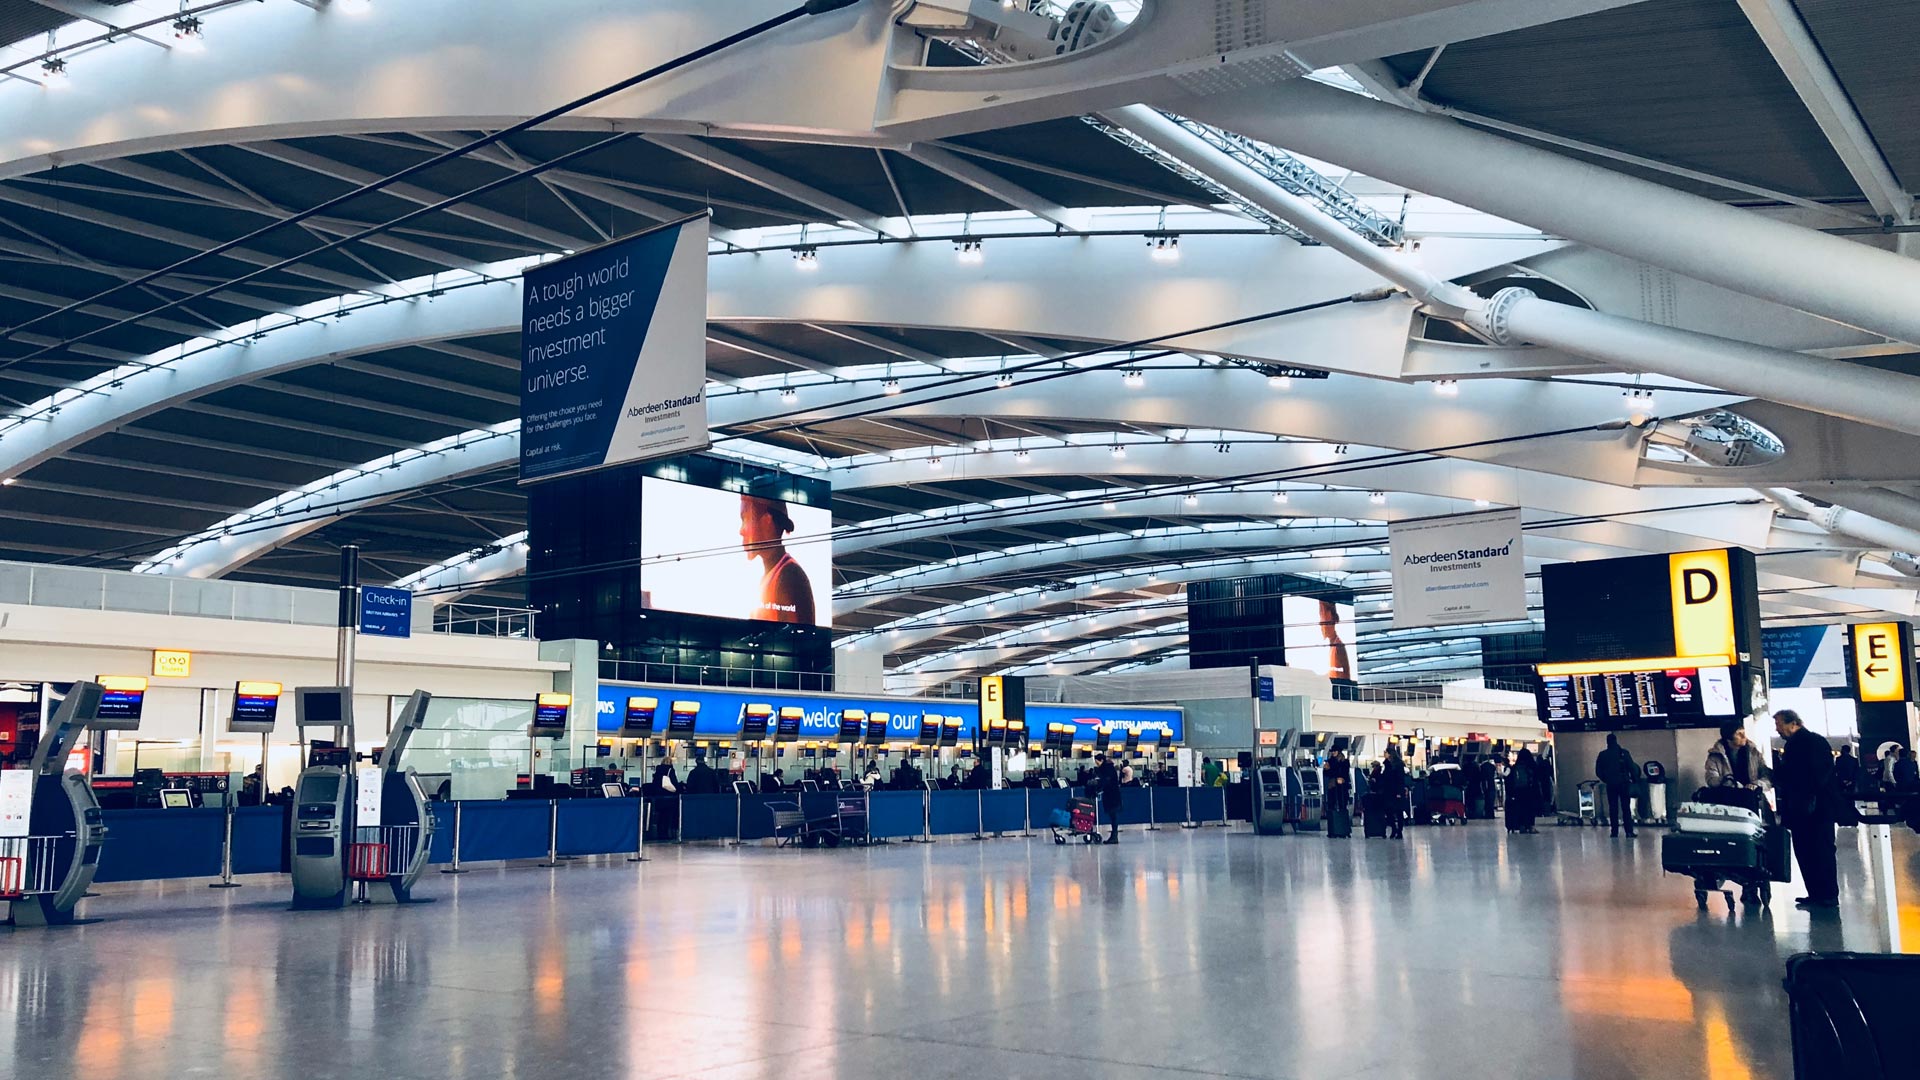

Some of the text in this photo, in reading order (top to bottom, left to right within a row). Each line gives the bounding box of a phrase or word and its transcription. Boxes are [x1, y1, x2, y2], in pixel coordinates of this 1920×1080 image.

[529, 256, 629, 306] A tough world
[529, 290, 635, 335] needs a bigger
[528, 327, 607, 364] investment
[528, 364, 589, 393] universe.
[526, 398, 603, 424] Offering the choice you need
[645, 410, 681, 424] Investments
[526, 425, 535, 434] for
[535, 423, 544, 432] the
[545, 418, 572, 429] challenges
[573, 415, 584, 426] you
[525, 445, 544, 459] Capital
[544, 444, 550, 453] at
[1430, 561, 1482, 573] Investments
[1683, 568, 1718, 605] D
[366, 592, 407, 606] Check-in
[781, 604, 796, 612] world
[1869, 634, 1888, 659] E
[988, 684, 997, 701] E
[892, 714, 918, 730] our
[1136, 720, 1168, 731] AIRWAYS
